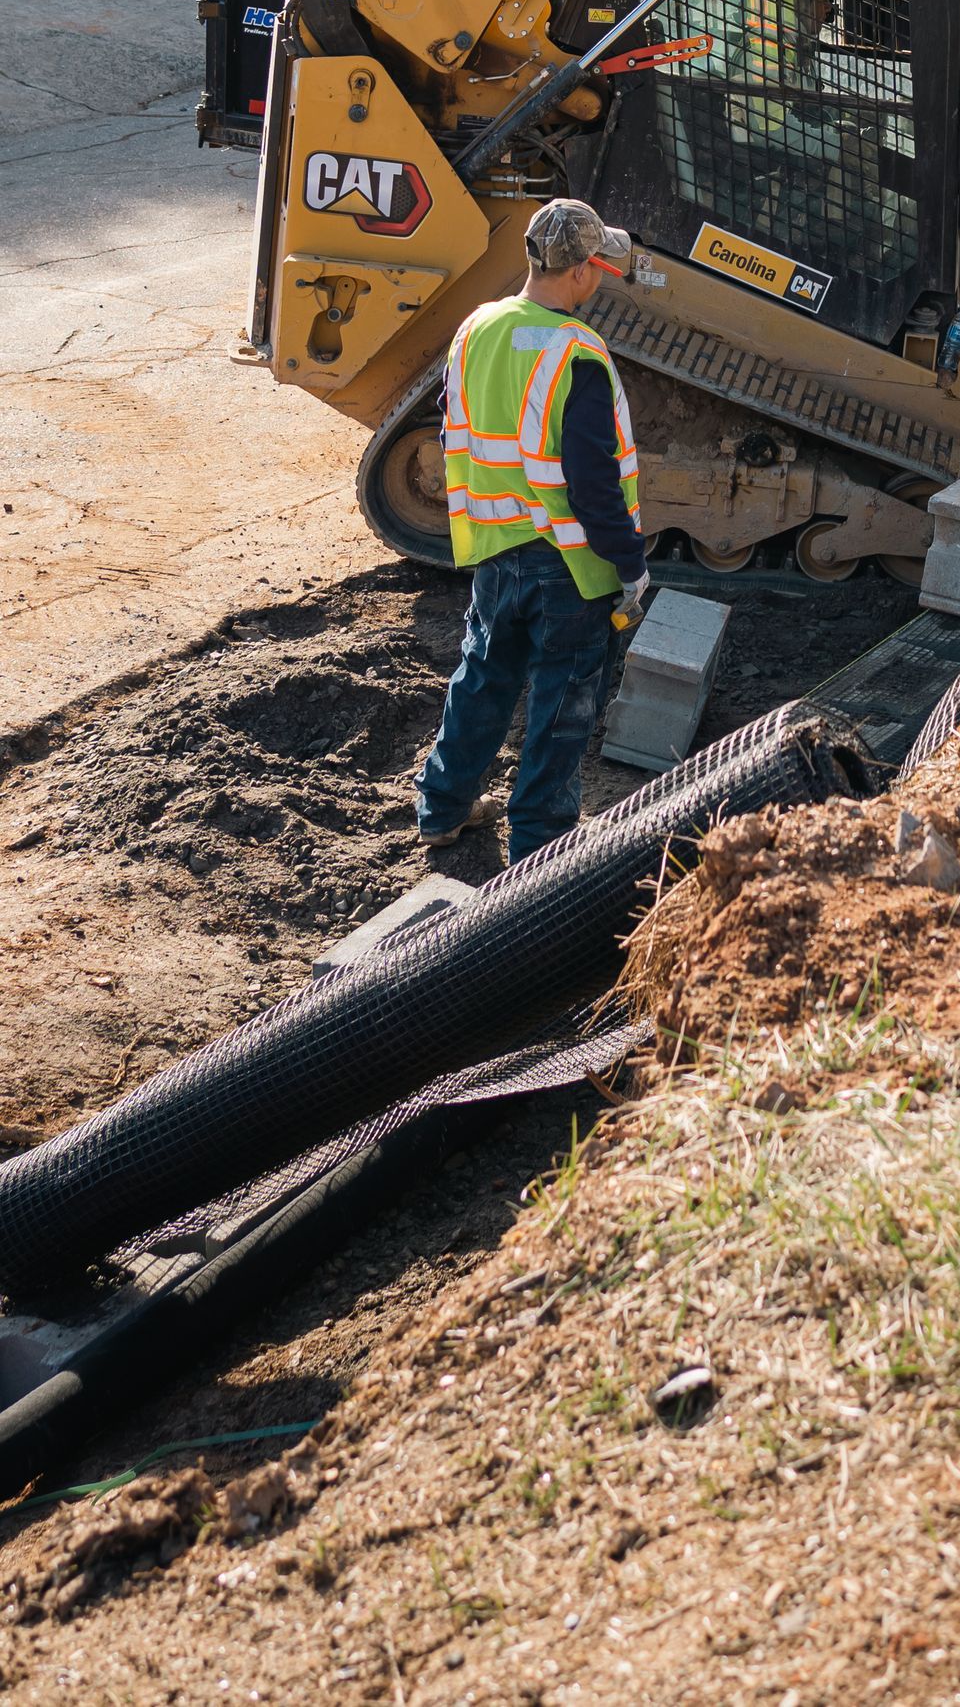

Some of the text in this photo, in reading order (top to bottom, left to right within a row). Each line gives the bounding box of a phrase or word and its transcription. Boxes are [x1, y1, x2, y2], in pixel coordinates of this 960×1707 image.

[306, 153, 403, 218] CAT
[708, 239, 823, 301] Carolina CAT
